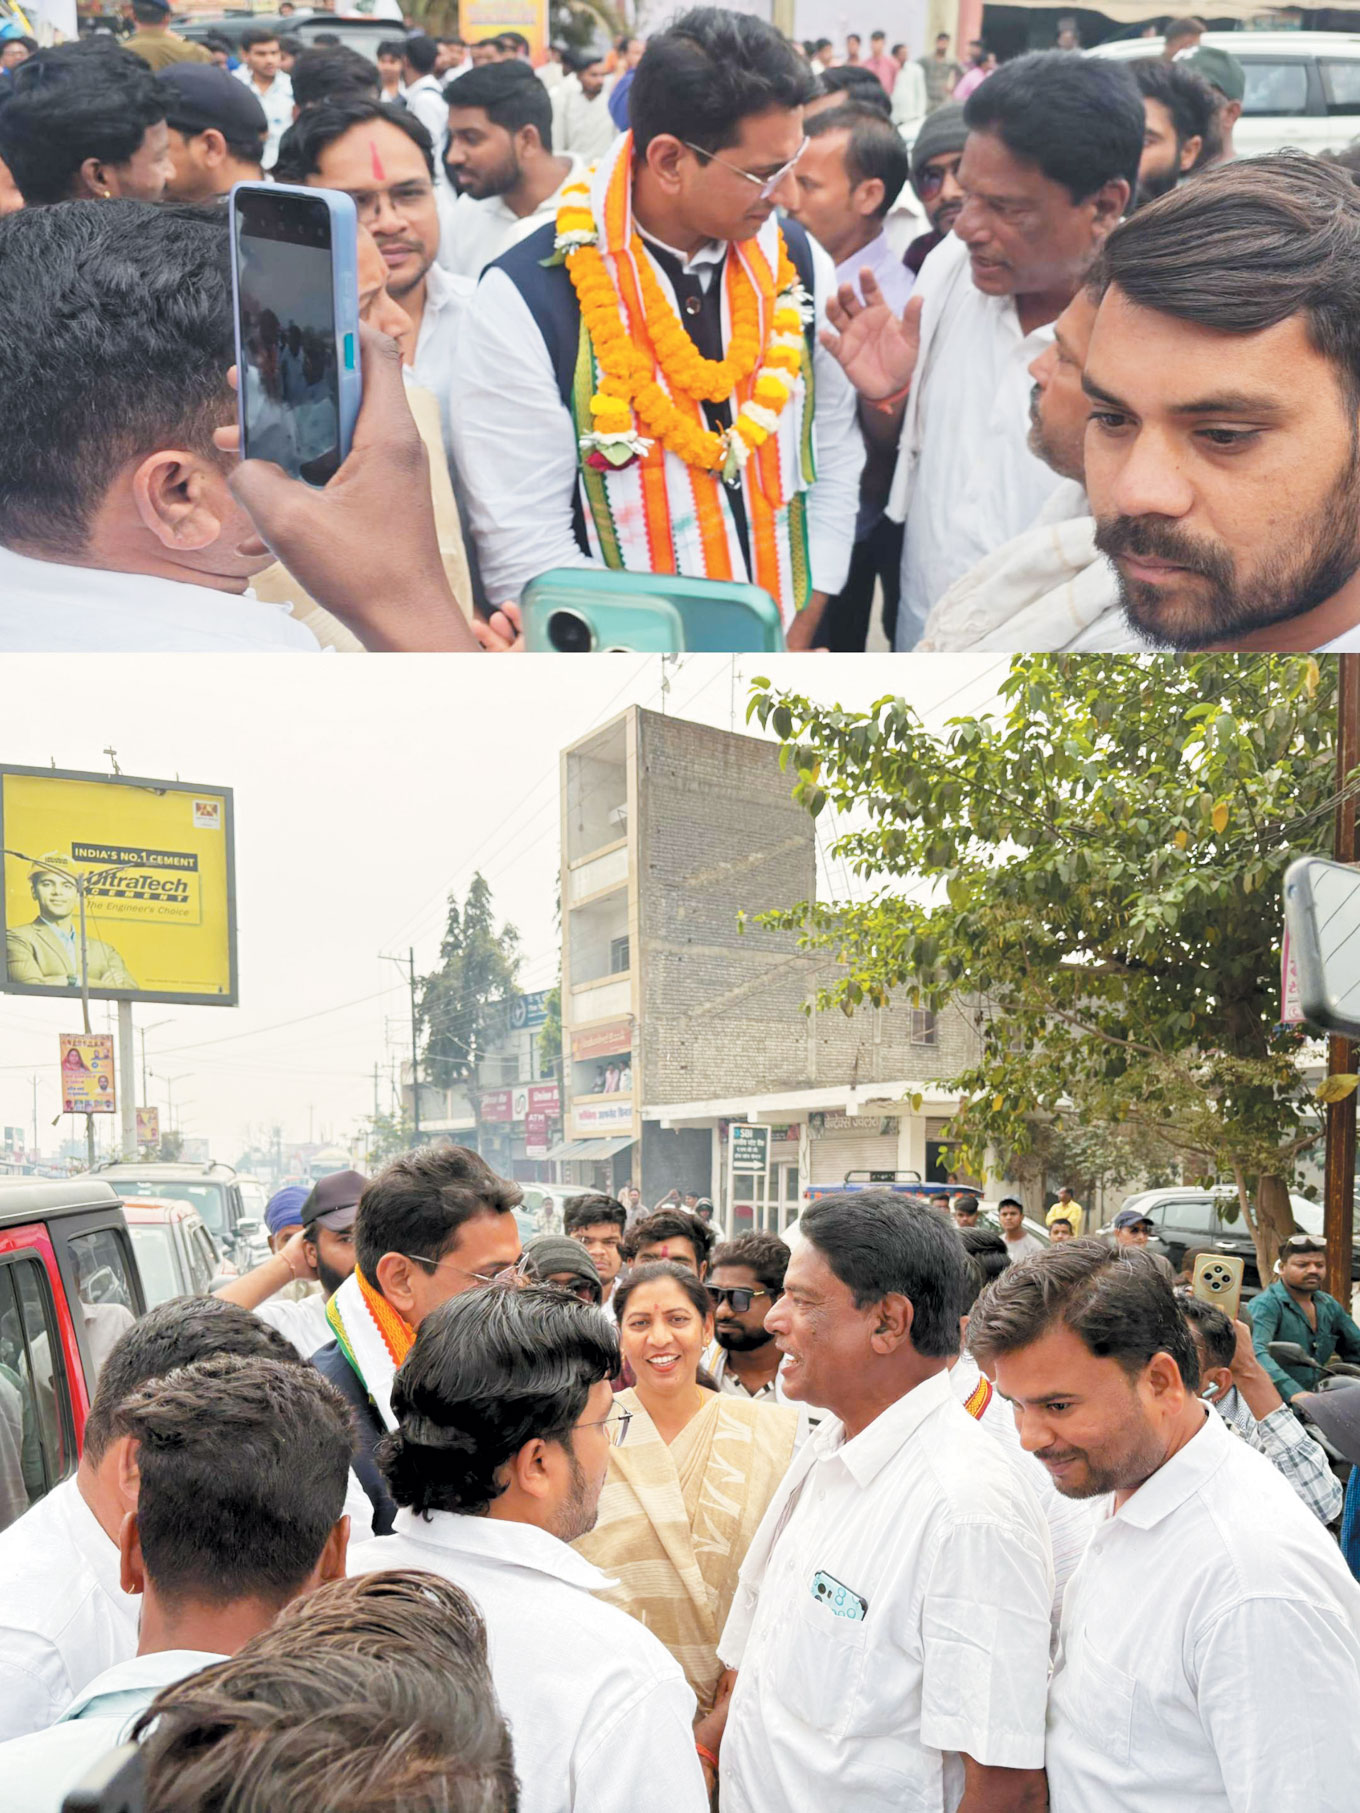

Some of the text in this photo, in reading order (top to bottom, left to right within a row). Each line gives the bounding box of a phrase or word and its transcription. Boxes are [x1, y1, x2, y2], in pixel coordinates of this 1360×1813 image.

[75, 847, 118, 860] INDIA'S
[120, 851, 147, 863] NO.1
[150, 854, 195, 867] CEMENT
[86, 870, 189, 893] UltraTech
[91, 888, 183, 902] CEMENT
[86, 900, 190, 917] The Engineer's Choice
